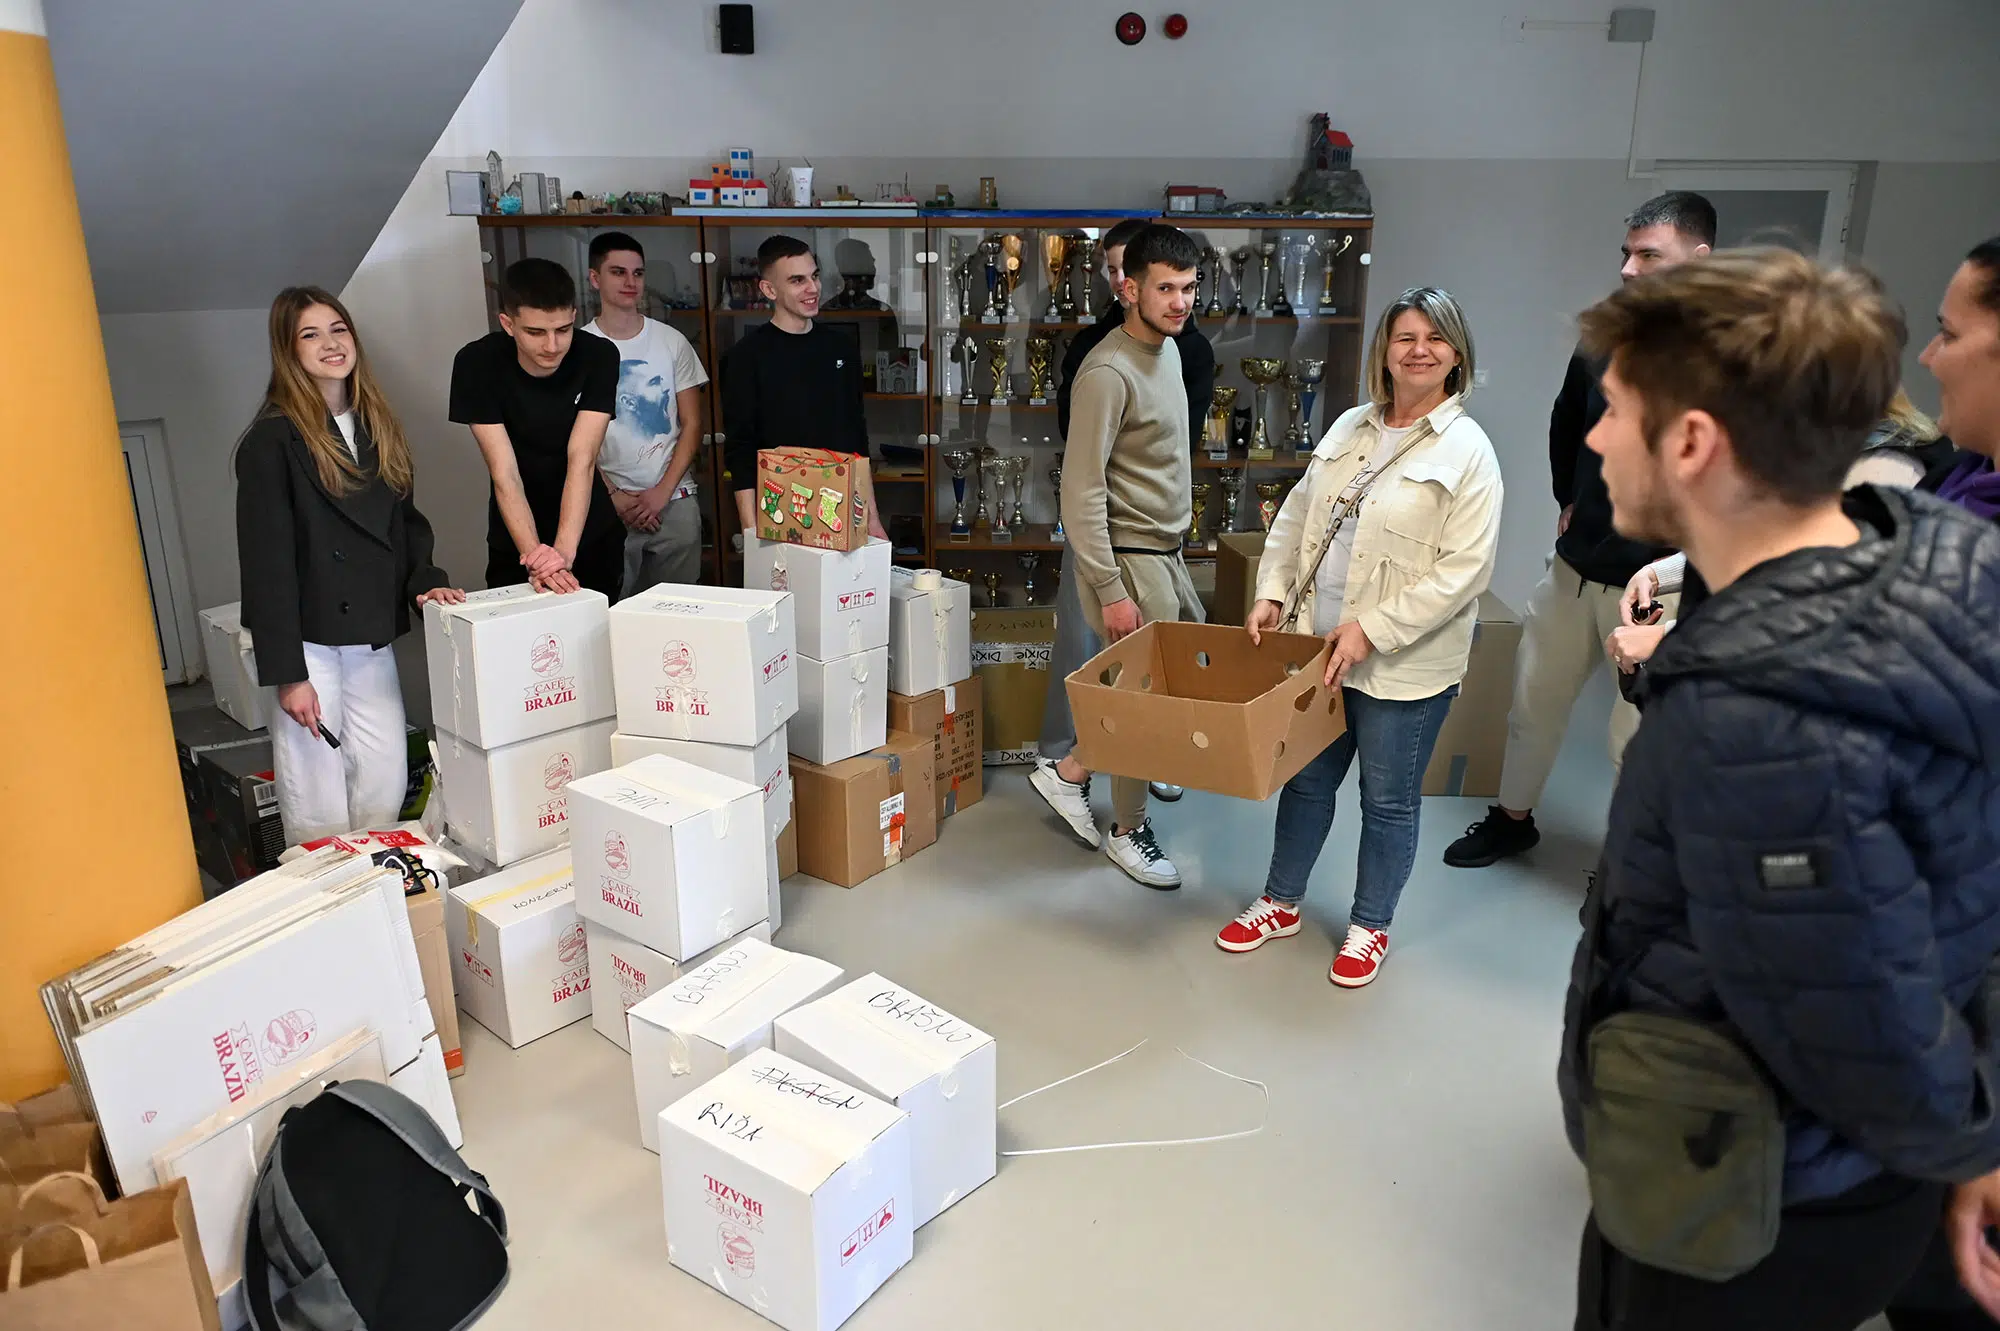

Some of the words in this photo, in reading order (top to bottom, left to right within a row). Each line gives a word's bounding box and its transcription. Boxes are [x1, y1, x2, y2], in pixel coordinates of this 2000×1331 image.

[524, 689, 577, 713] BRAZIL
[655, 699, 710, 716] BRZIL
[1000, 751, 1036, 762] Dixie
[538, 811, 569, 829] BRA
[601, 888, 643, 918] BRAZIL
[610, 953, 647, 986] BRAZIL
[213, 1030, 246, 1103] BRAZIL
[703, 1173, 763, 1217] BRAZIL
